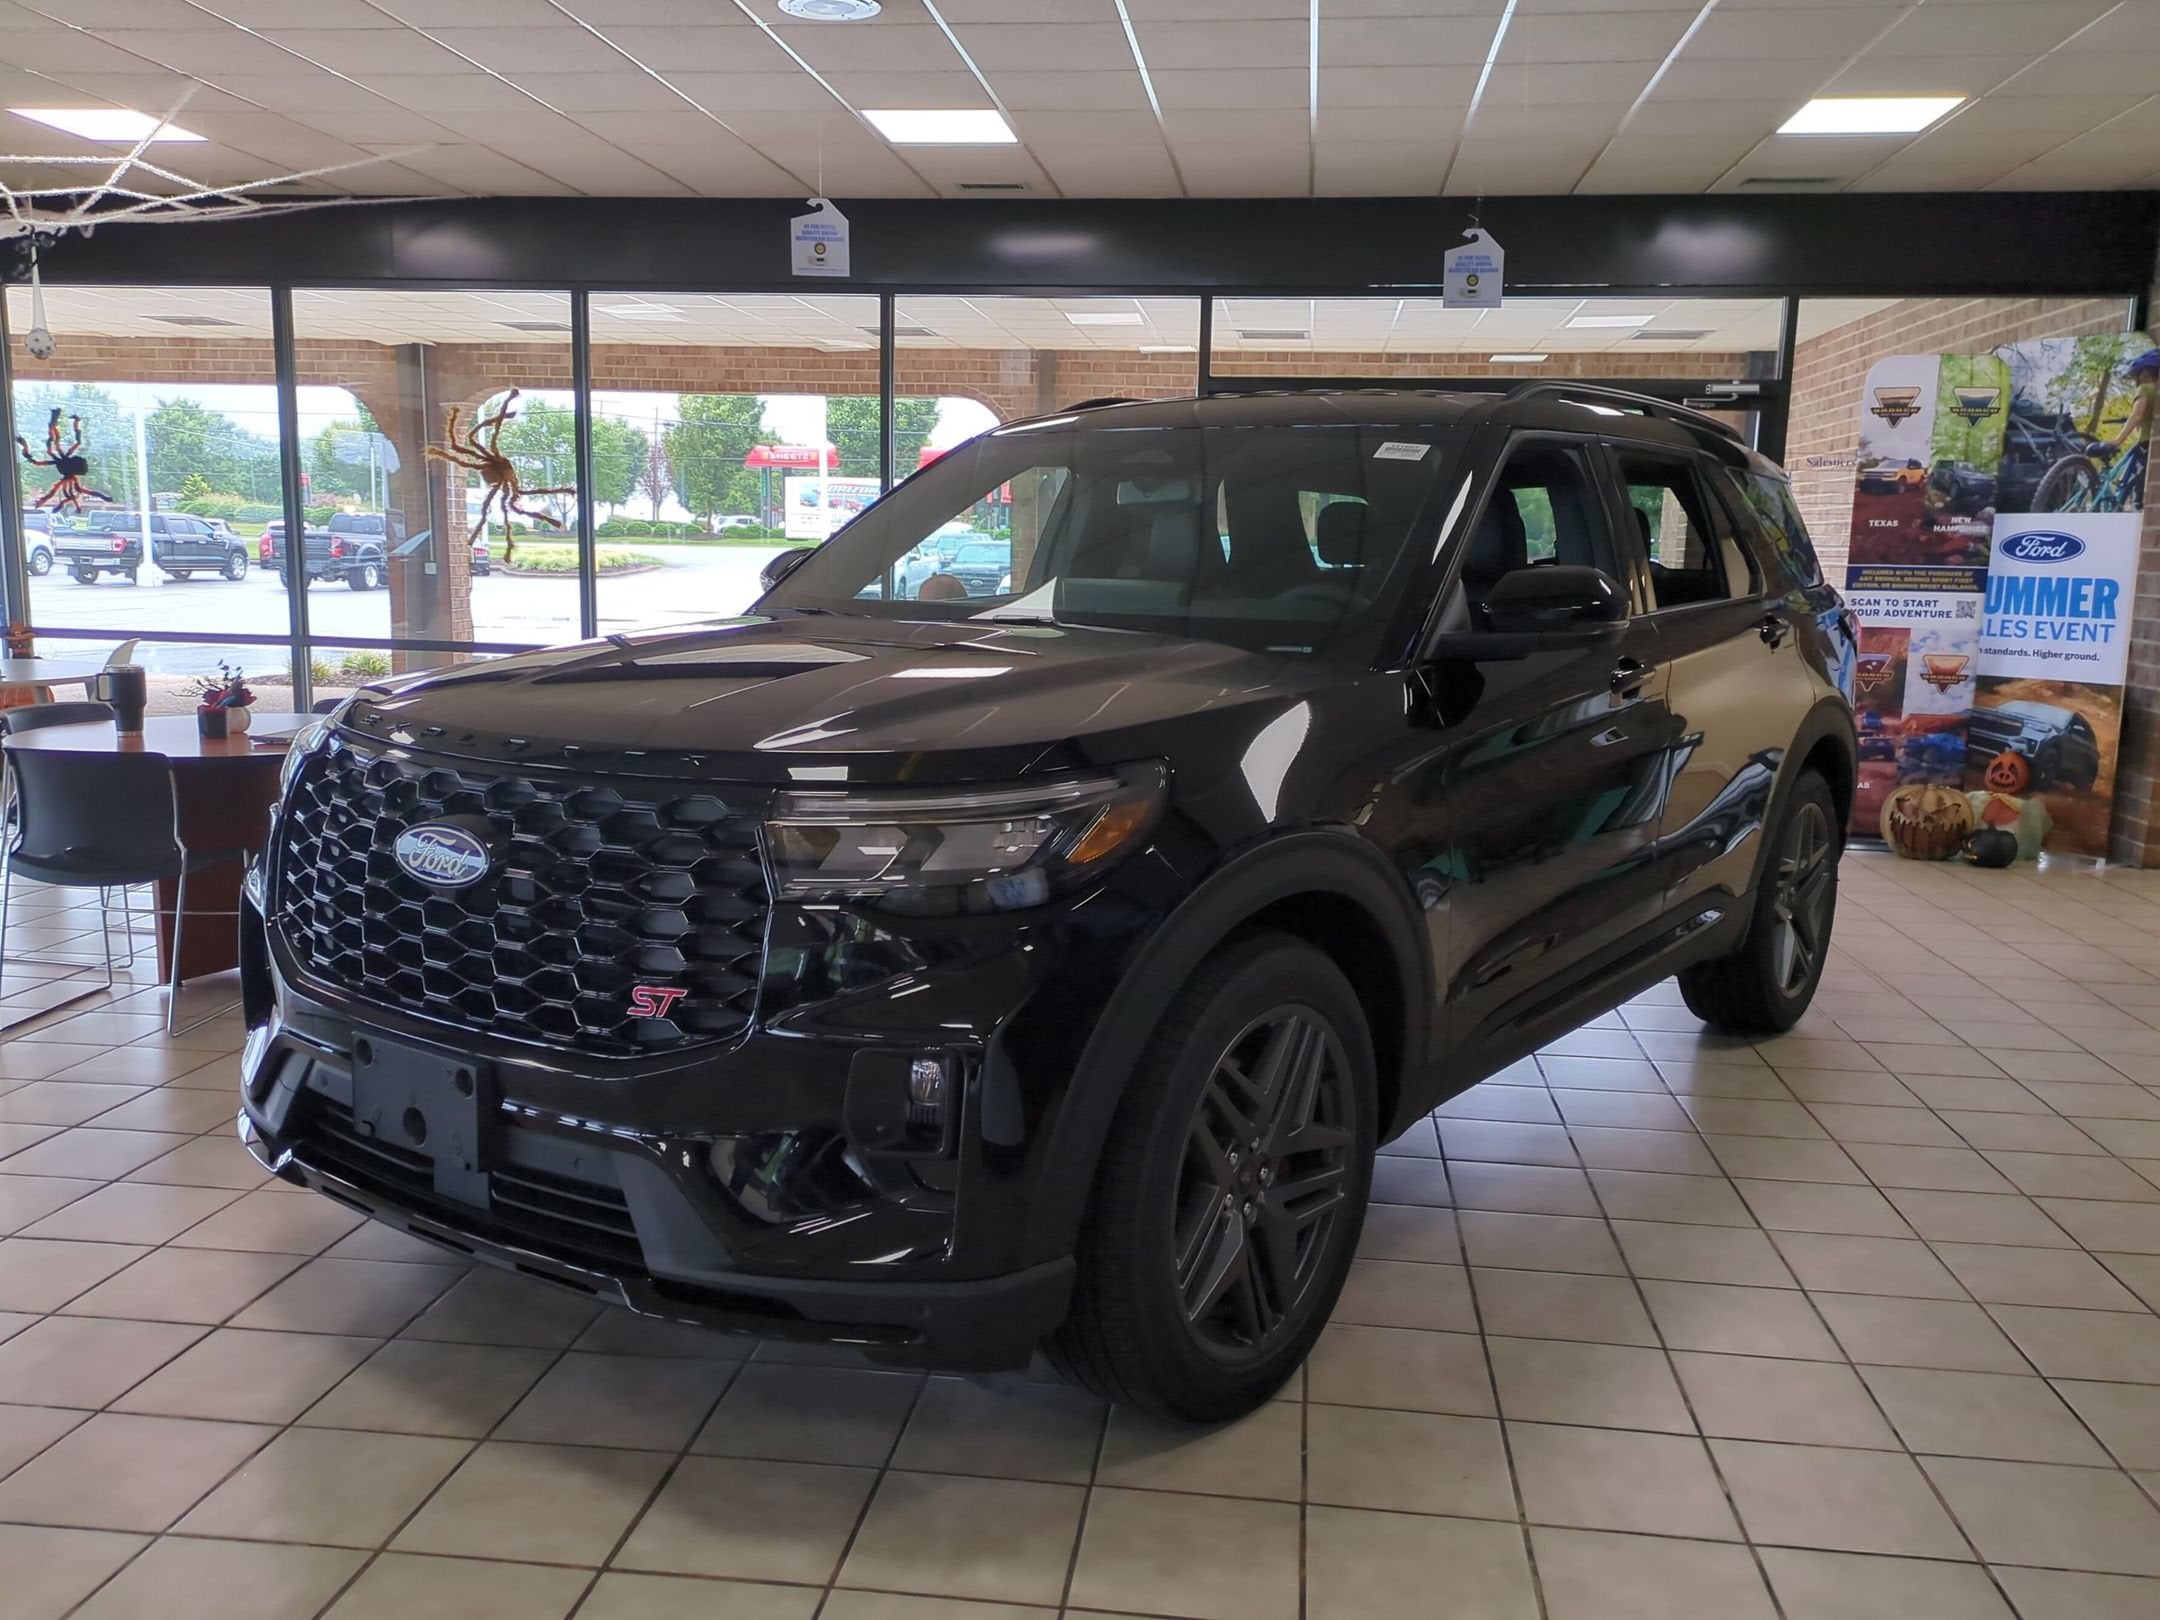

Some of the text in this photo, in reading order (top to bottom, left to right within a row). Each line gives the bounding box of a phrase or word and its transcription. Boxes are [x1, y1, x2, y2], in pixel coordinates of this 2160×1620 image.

[769, 452, 809, 460] SHEETZ
[1806, 457, 1857, 468] Salespers
[1933, 525, 1988, 533] HAMPSHIRE
[2015, 535, 2068, 557] Ford
[1850, 598, 1939, 608] SCAN TO START
[1984, 576, 2119, 619] UMMER
[1850, 609, 1953, 619] YOUR ADVENTURE
[1978, 618, 2115, 643] LES EVENT
[1984, 647, 2031, 657] standards.
[2032, 649, 2063, 660] Higher
[2064, 652, 2100, 662] ground.
[407, 831, 471, 877] Ford
[626, 985, 688, 1018] ST
